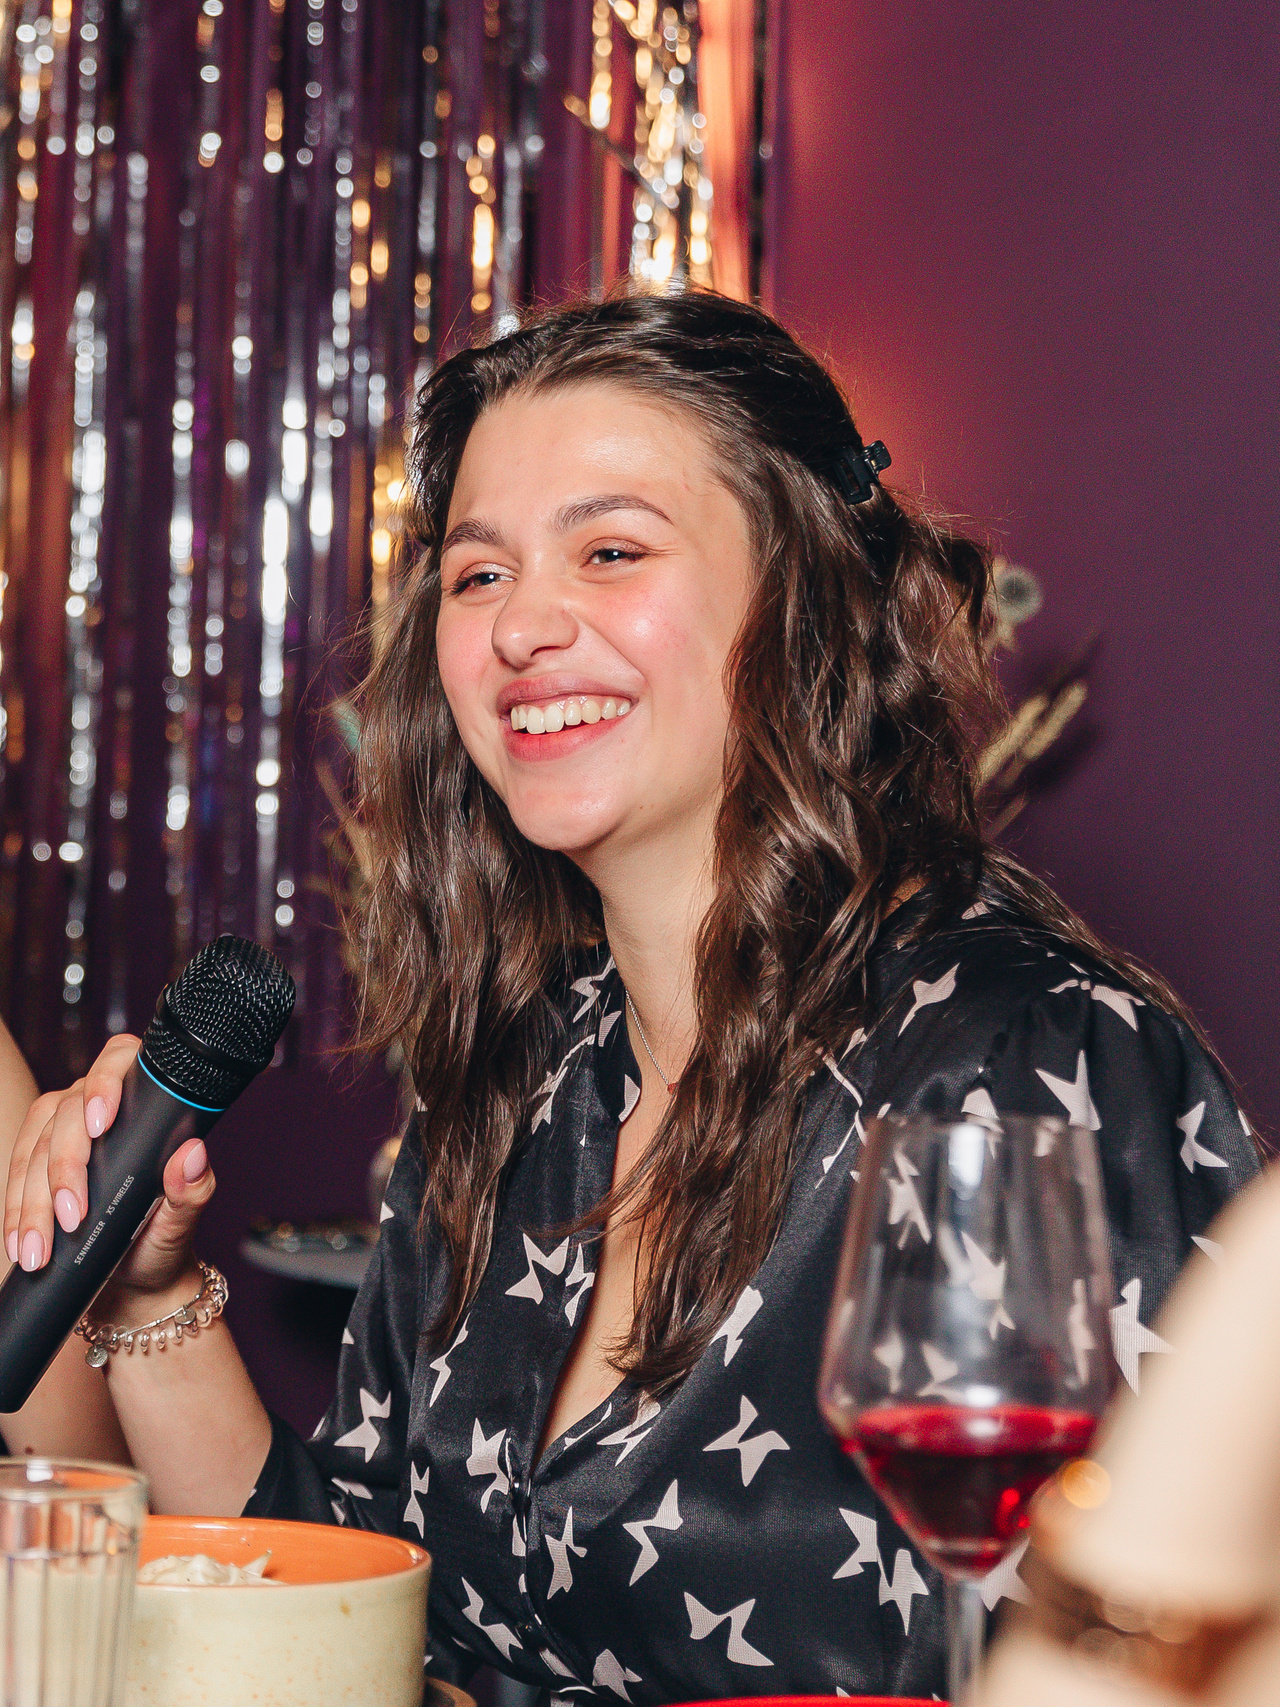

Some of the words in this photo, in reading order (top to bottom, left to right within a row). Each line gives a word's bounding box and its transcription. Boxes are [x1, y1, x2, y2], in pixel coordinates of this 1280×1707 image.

[73, 1220, 106, 1265] SENNHEISER
[105, 1204, 116, 1216] XS
[111, 1174, 135, 1206] WIRELESS
